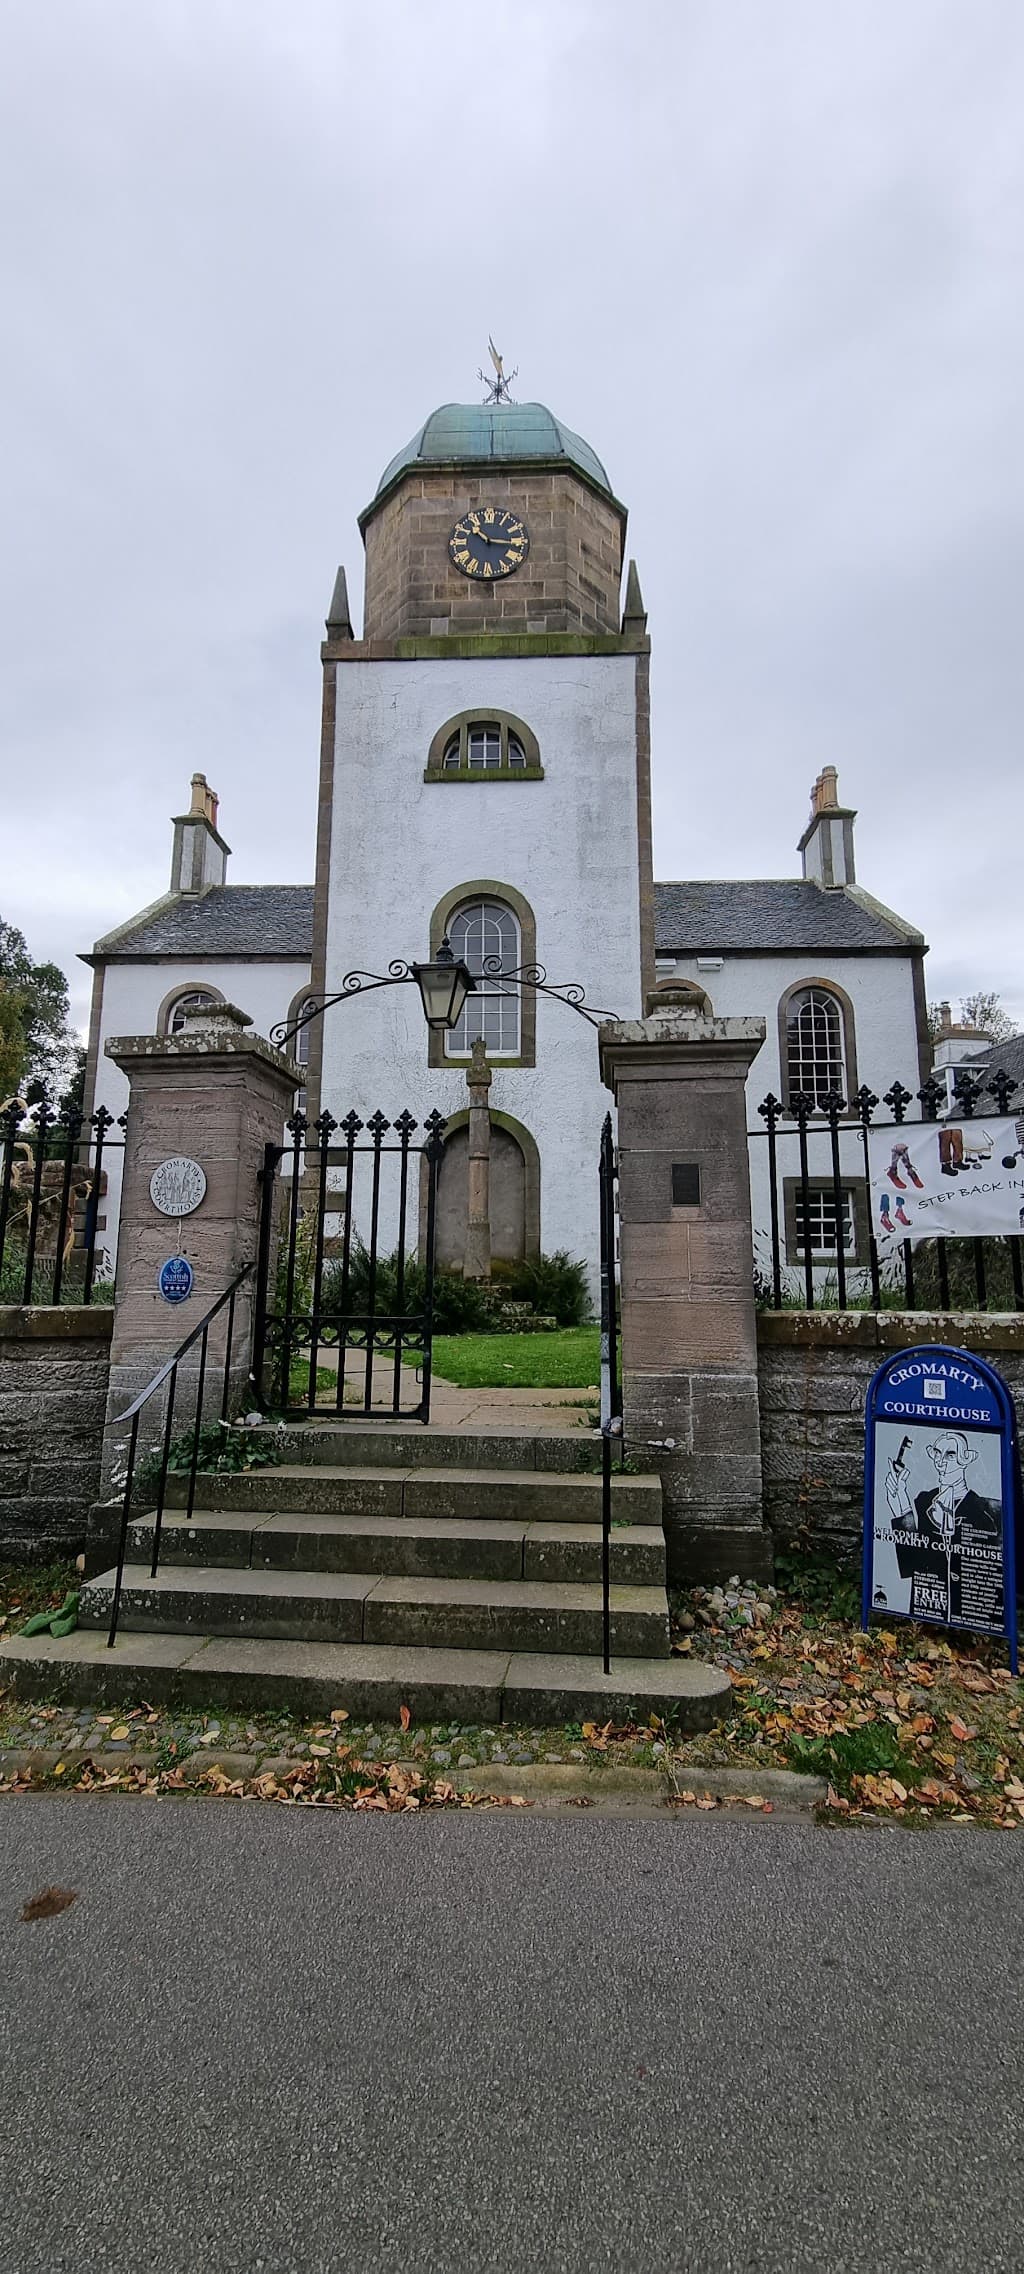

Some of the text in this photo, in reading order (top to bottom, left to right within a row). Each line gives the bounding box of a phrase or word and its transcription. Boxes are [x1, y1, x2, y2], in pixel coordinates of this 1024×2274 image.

[918, 1191, 955, 1210] STEP
[959, 1182, 1004, 1197] BACK
[888, 1363, 985, 1391] CROMARTY
[884, 1401, 991, 1422] COURTHOUSE
[874, 1526, 920, 1541] WELCOME
[874, 1533, 929, 1549] CROMARTY
[931, 1541, 1003, 1561] COURTHOUSE
[913, 1586, 947, 1603] FREE
[914, 1597, 948, 1611] ENTRY
